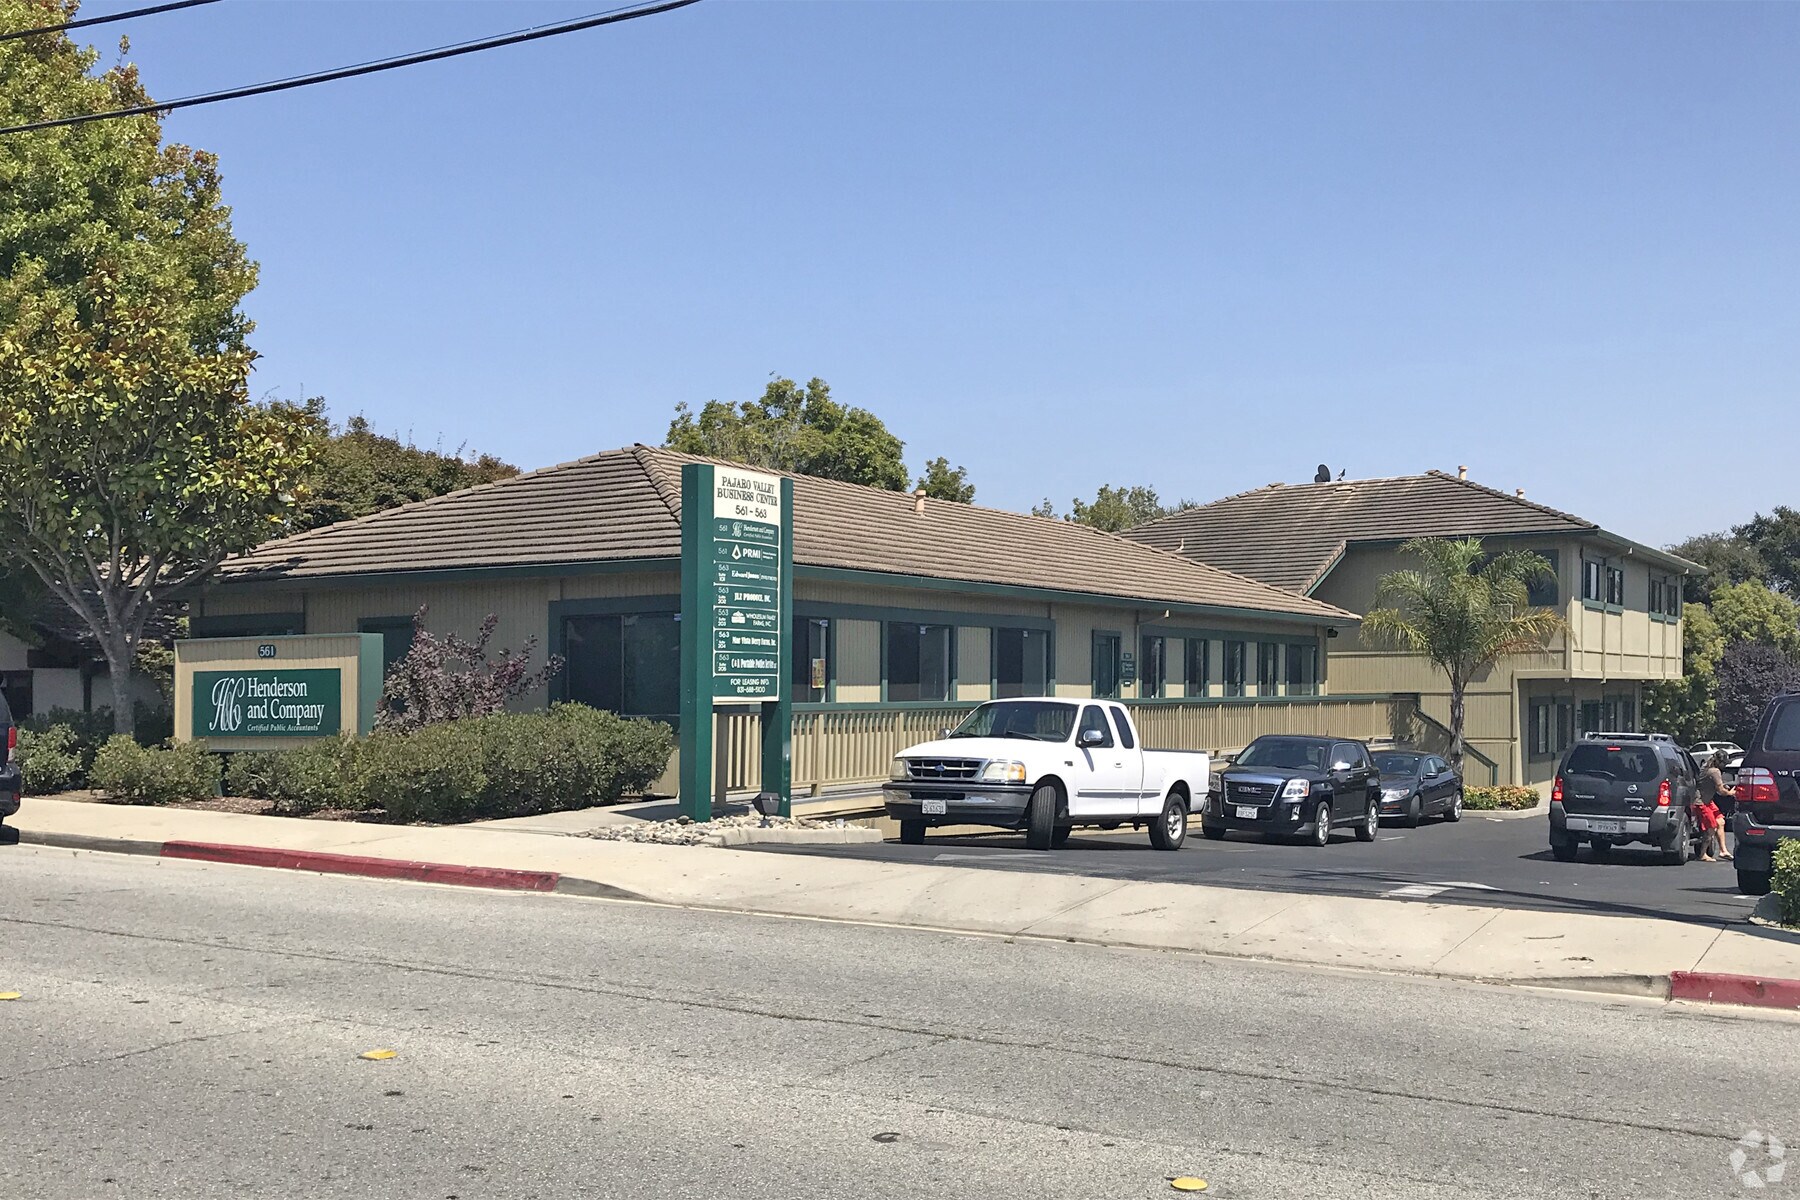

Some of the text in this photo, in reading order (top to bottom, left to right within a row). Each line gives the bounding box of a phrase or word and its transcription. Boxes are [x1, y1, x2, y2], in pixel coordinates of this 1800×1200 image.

[722, 476, 775, 495] PAJARO VALLEY
[717, 488, 778, 506] BUSINESS CENTER
[736, 505, 748, 515] 561
[754, 508, 767, 518] 563
[742, 548, 760, 558] PRMI
[260, 645, 274, 657] 561
[248, 676, 307, 698] Henderson
[248, 698, 324, 725] and Company
[247, 724, 269, 733] Certified
[287, 724, 318, 732] Accountants
[1238, 786, 1262, 794] GMC
